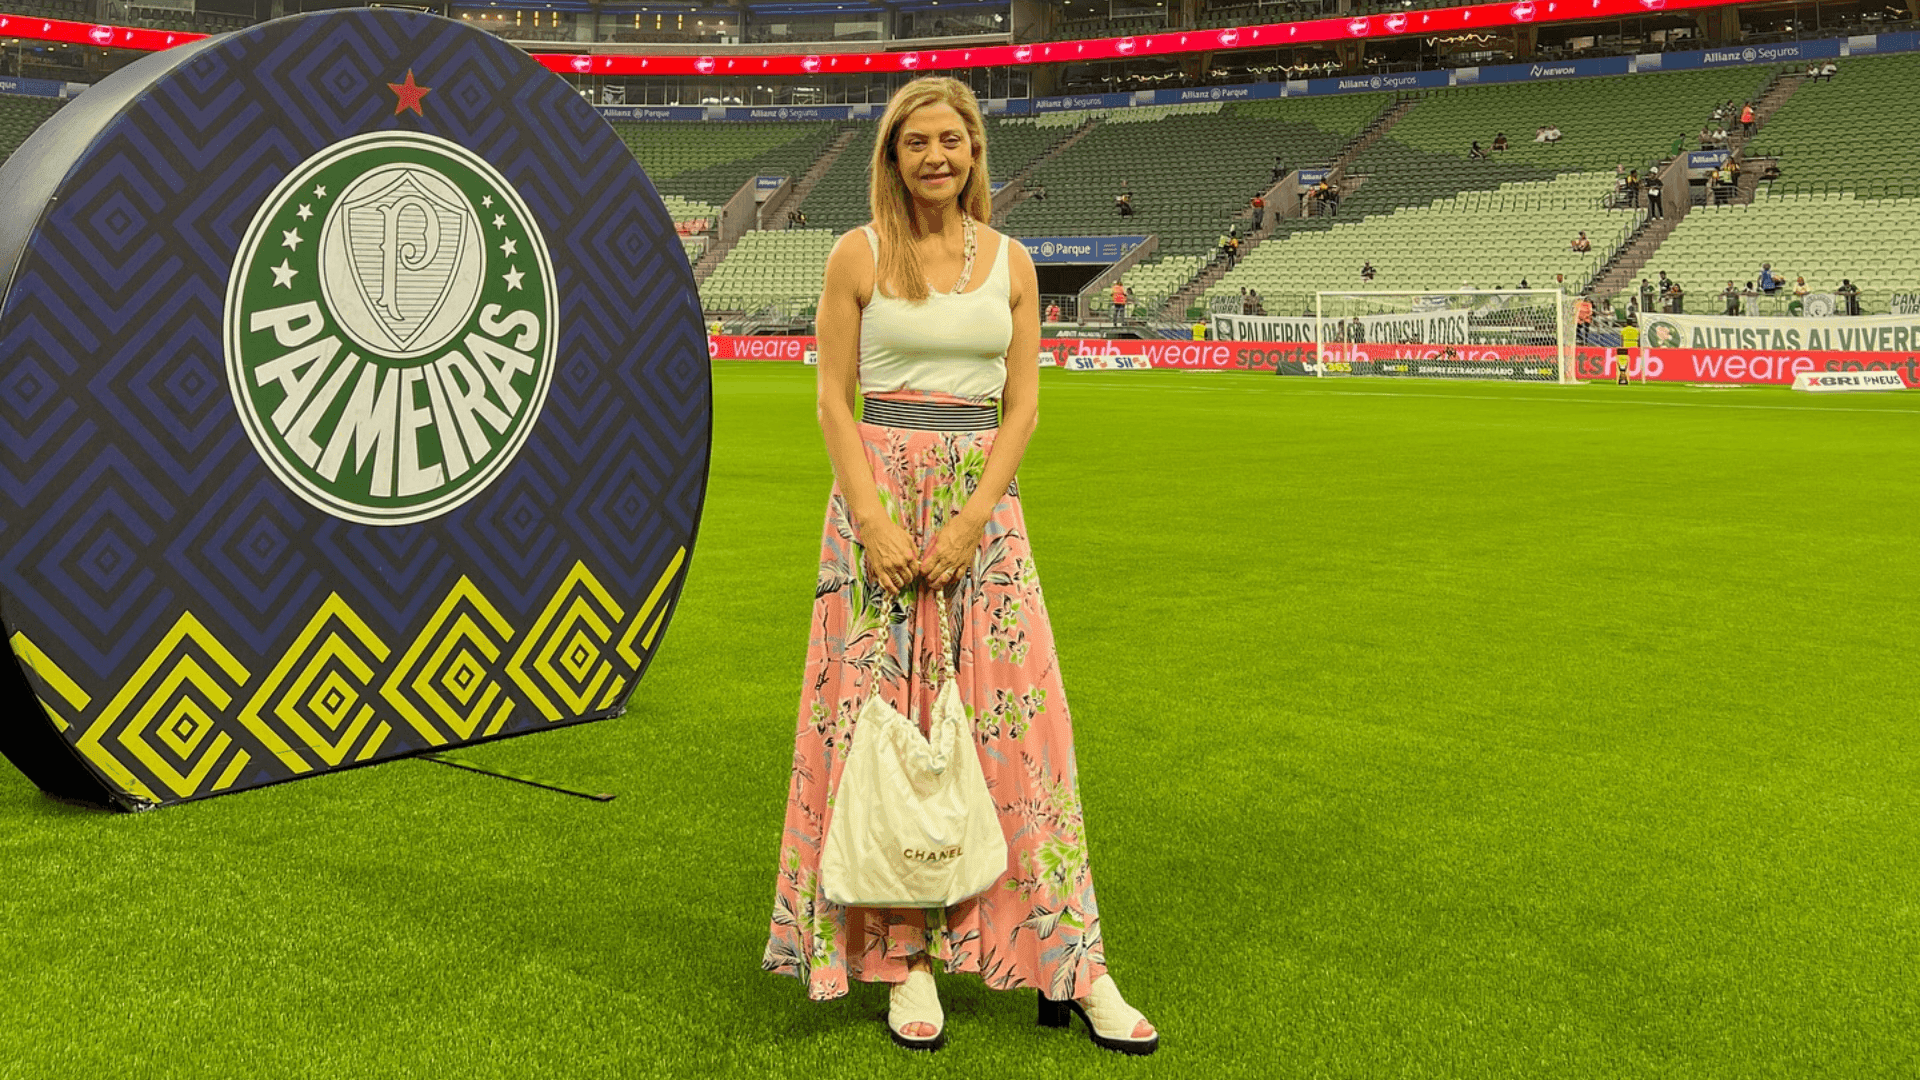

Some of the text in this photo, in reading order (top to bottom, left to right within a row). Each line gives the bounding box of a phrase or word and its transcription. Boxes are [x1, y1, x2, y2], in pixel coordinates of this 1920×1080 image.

[1704, 46, 1799, 63] Allianz Seguros
[1543, 67, 1575, 76] NEWON
[0, 82, 17, 91] que
[1338, 76, 1417, 89] Allianz Seguros
[1181, 88, 1248, 100] Allianz Parque
[1036, 99, 1061, 109] Allianz
[603, 109, 670, 119] Allianz Parque
[750, 109, 777, 118] Allianz
[1056, 243, 1091, 257] Parque
[1892, 293, 1920, 306] CAN
[1692, 326, 1801, 349] AUTISTAS
[1075, 357, 1094, 369] Sil
[1115, 357, 1134, 368] Sil
[1864, 376, 1901, 385] PNEUS
[250, 301, 541, 498] PALMEIRAS
[903, 847, 964, 862] CHANEL
